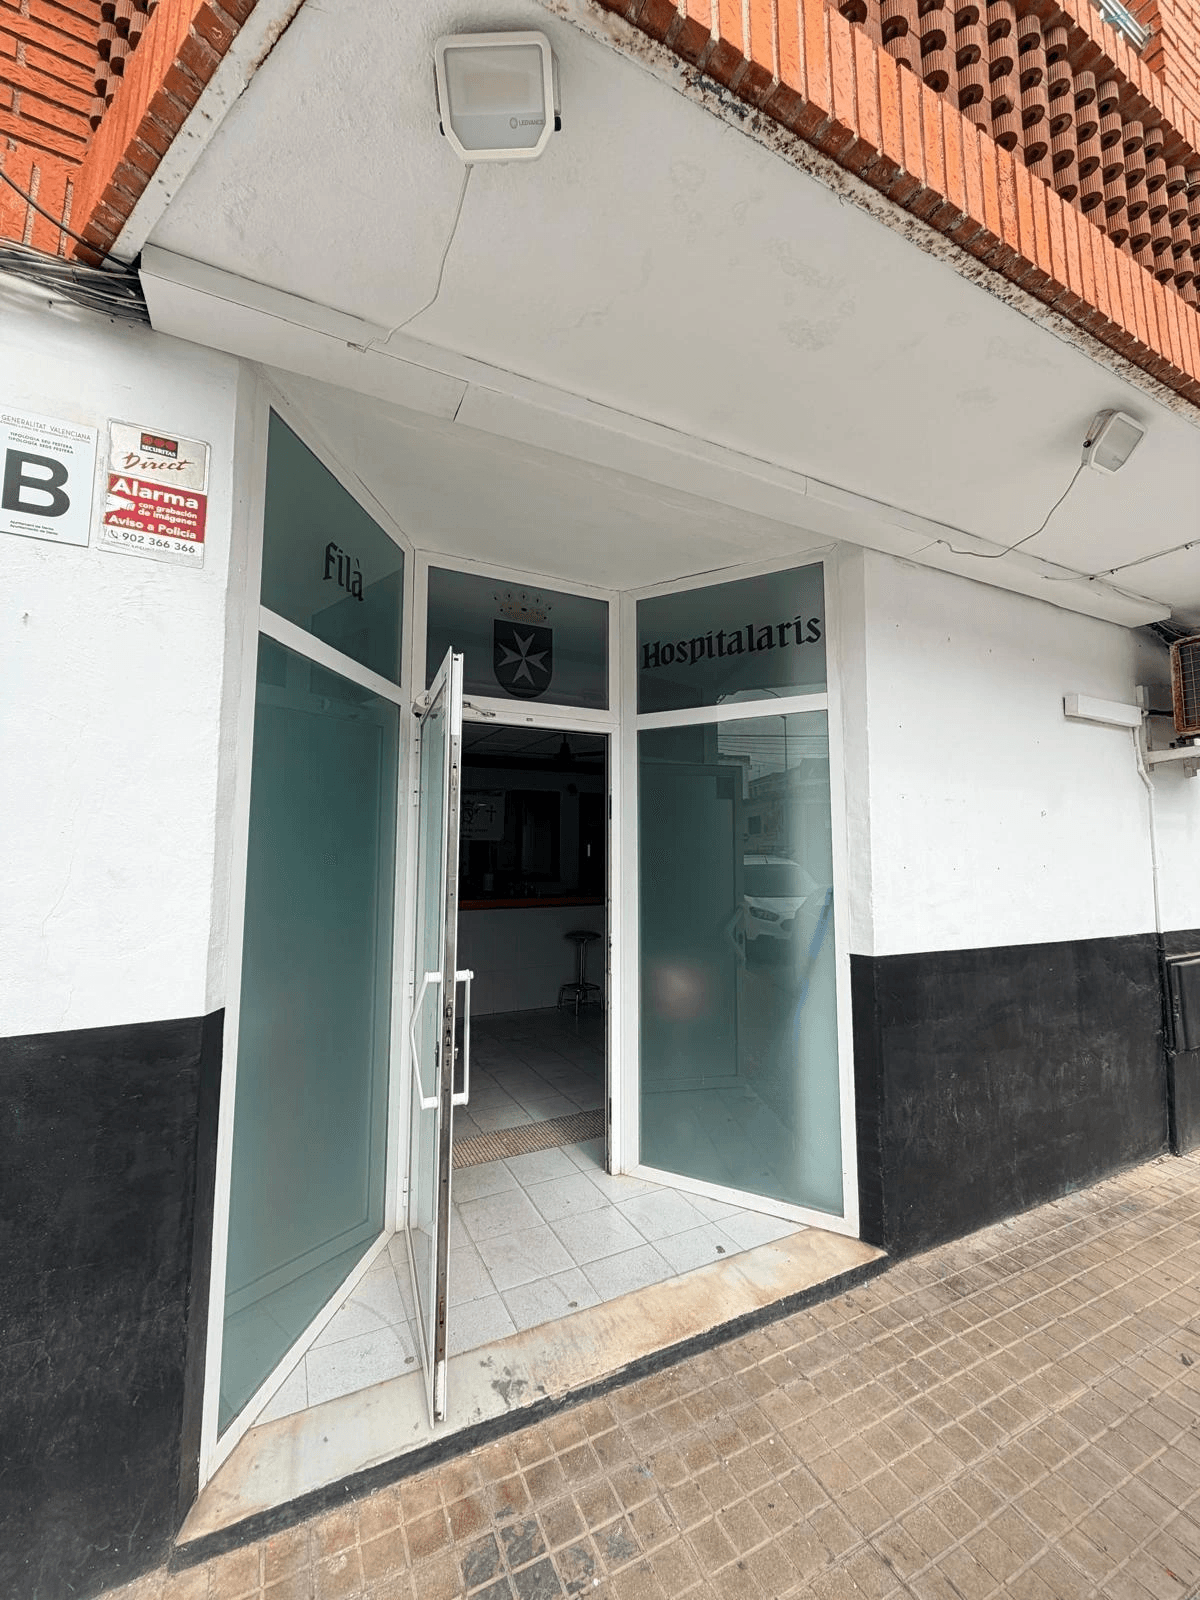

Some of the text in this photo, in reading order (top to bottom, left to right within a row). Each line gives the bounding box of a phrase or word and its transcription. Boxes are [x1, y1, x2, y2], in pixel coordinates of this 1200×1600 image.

[1, 414, 47, 430] GENERALITAT
[50, 425, 91, 441] VALENCIANA
[52, 441, 73, 450] FESTERA
[53, 446, 74, 454] FESTERA
[141, 444, 177, 457] SECURITAS
[122, 452, 194, 471] Direct
[2, 448, 70, 517] B
[111, 479, 199, 510] Alarma
[138, 502, 198, 519] con grabación
[138, 508, 197, 527] de imágenes
[108, 514, 144, 529] Aviso
[147, 523, 155, 532] a
[122, 532, 145, 543] 902
[148, 537, 171, 549] 366
[174, 542, 196, 554] 366
[323, 541, 364, 602] Filà
[641, 615, 822, 670] Hospitalaris
